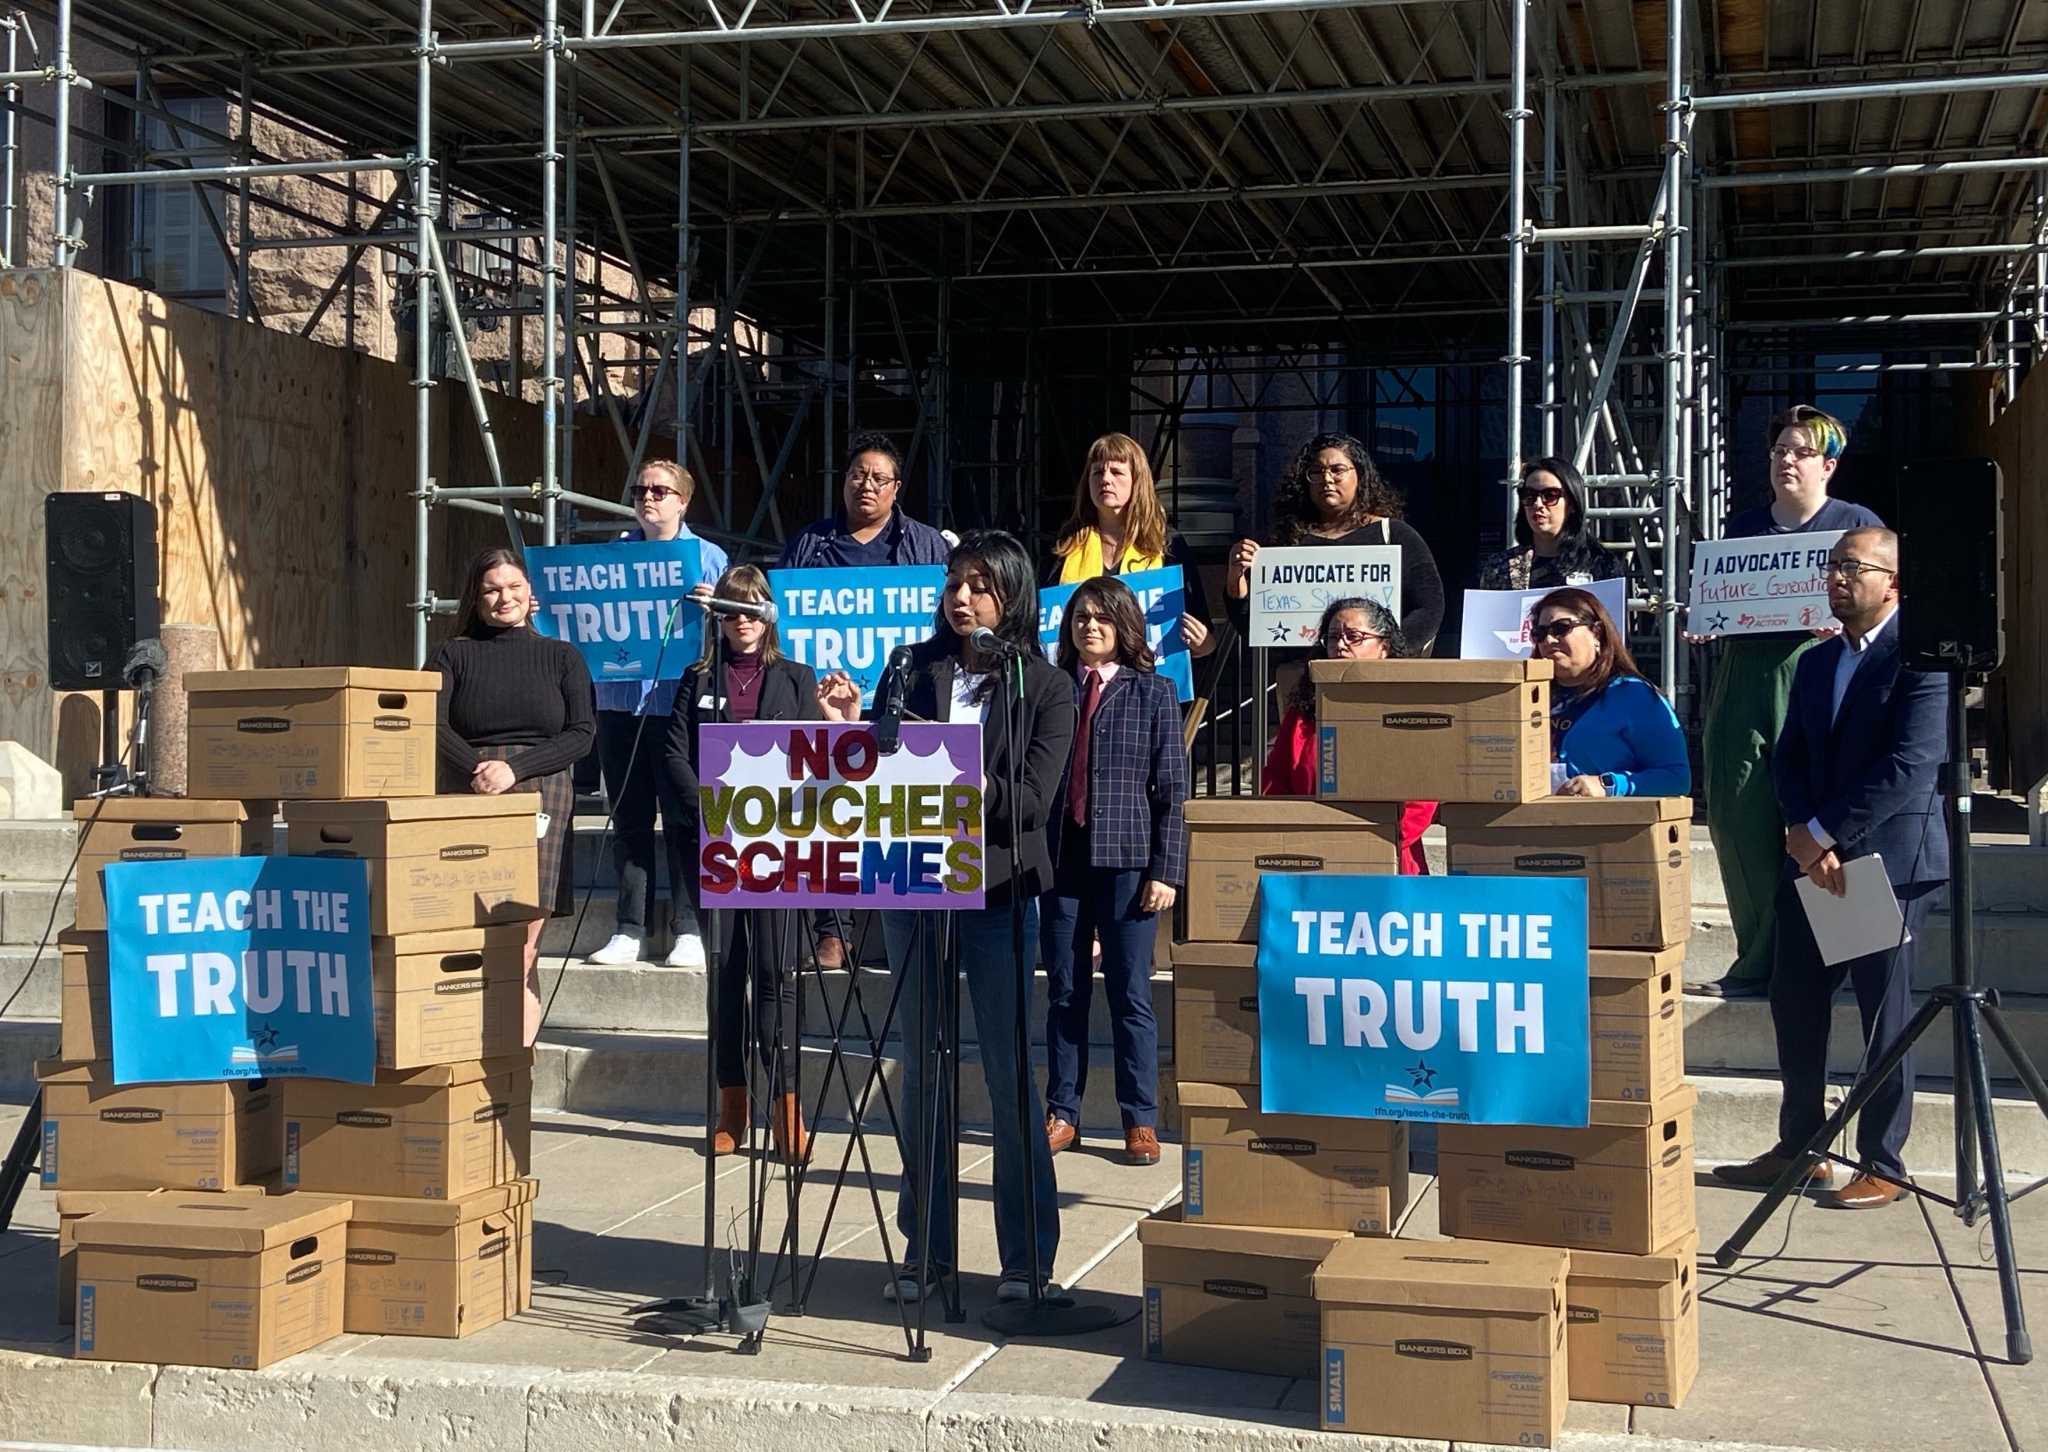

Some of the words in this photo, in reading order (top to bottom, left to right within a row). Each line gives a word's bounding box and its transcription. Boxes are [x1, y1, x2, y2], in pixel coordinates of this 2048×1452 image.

[543, 563, 627, 592] TEACH
[633, 560, 684, 588] THE
[1262, 566, 1266, 584] I
[1272, 564, 1354, 584] ADVOCATE
[1361, 564, 1391, 582] FOR
[1703, 558, 1709, 575] I
[1714, 551, 1800, 575] ADVOCATE
[784, 588, 874, 616] TEACH
[883, 587, 936, 614] THE
[1700, 579, 1759, 604] Future
[550, 599, 684, 643] TRUTH
[787, 729, 879, 782] NO
[1324, 736, 1334, 784] SMALL
[700, 785, 982, 838] VOUCHER
[701, 841, 983, 895] SCHEMES
[138, 889, 282, 934] TEACH
[292, 890, 349, 933] THE
[1291, 911, 1442, 957] TEACH
[1459, 913, 1552, 960] THE
[146, 950, 350, 1017] TRUTH
[437, 983, 470, 991] BANKERS
[1294, 977, 1545, 1054] TRUTH
[1375, 1107, 1470, 1120] tfn.org/teach-the-truth
[45, 1130, 56, 1173] SMALL
[287, 1132, 298, 1174] SMALL
[1251, 1142, 1293, 1150] BANKERS
[1190, 1159, 1200, 1206] SMALL
[139, 1278, 177, 1287] BANKERS
[83, 1296, 93, 1342] SMALL
[1150, 1297, 1160, 1344] SMALL
[1399, 1345, 1447, 1354] BANKERS
[1448, 1347, 1469, 1356] BOX
[1330, 1361, 1341, 1412] SMALL
